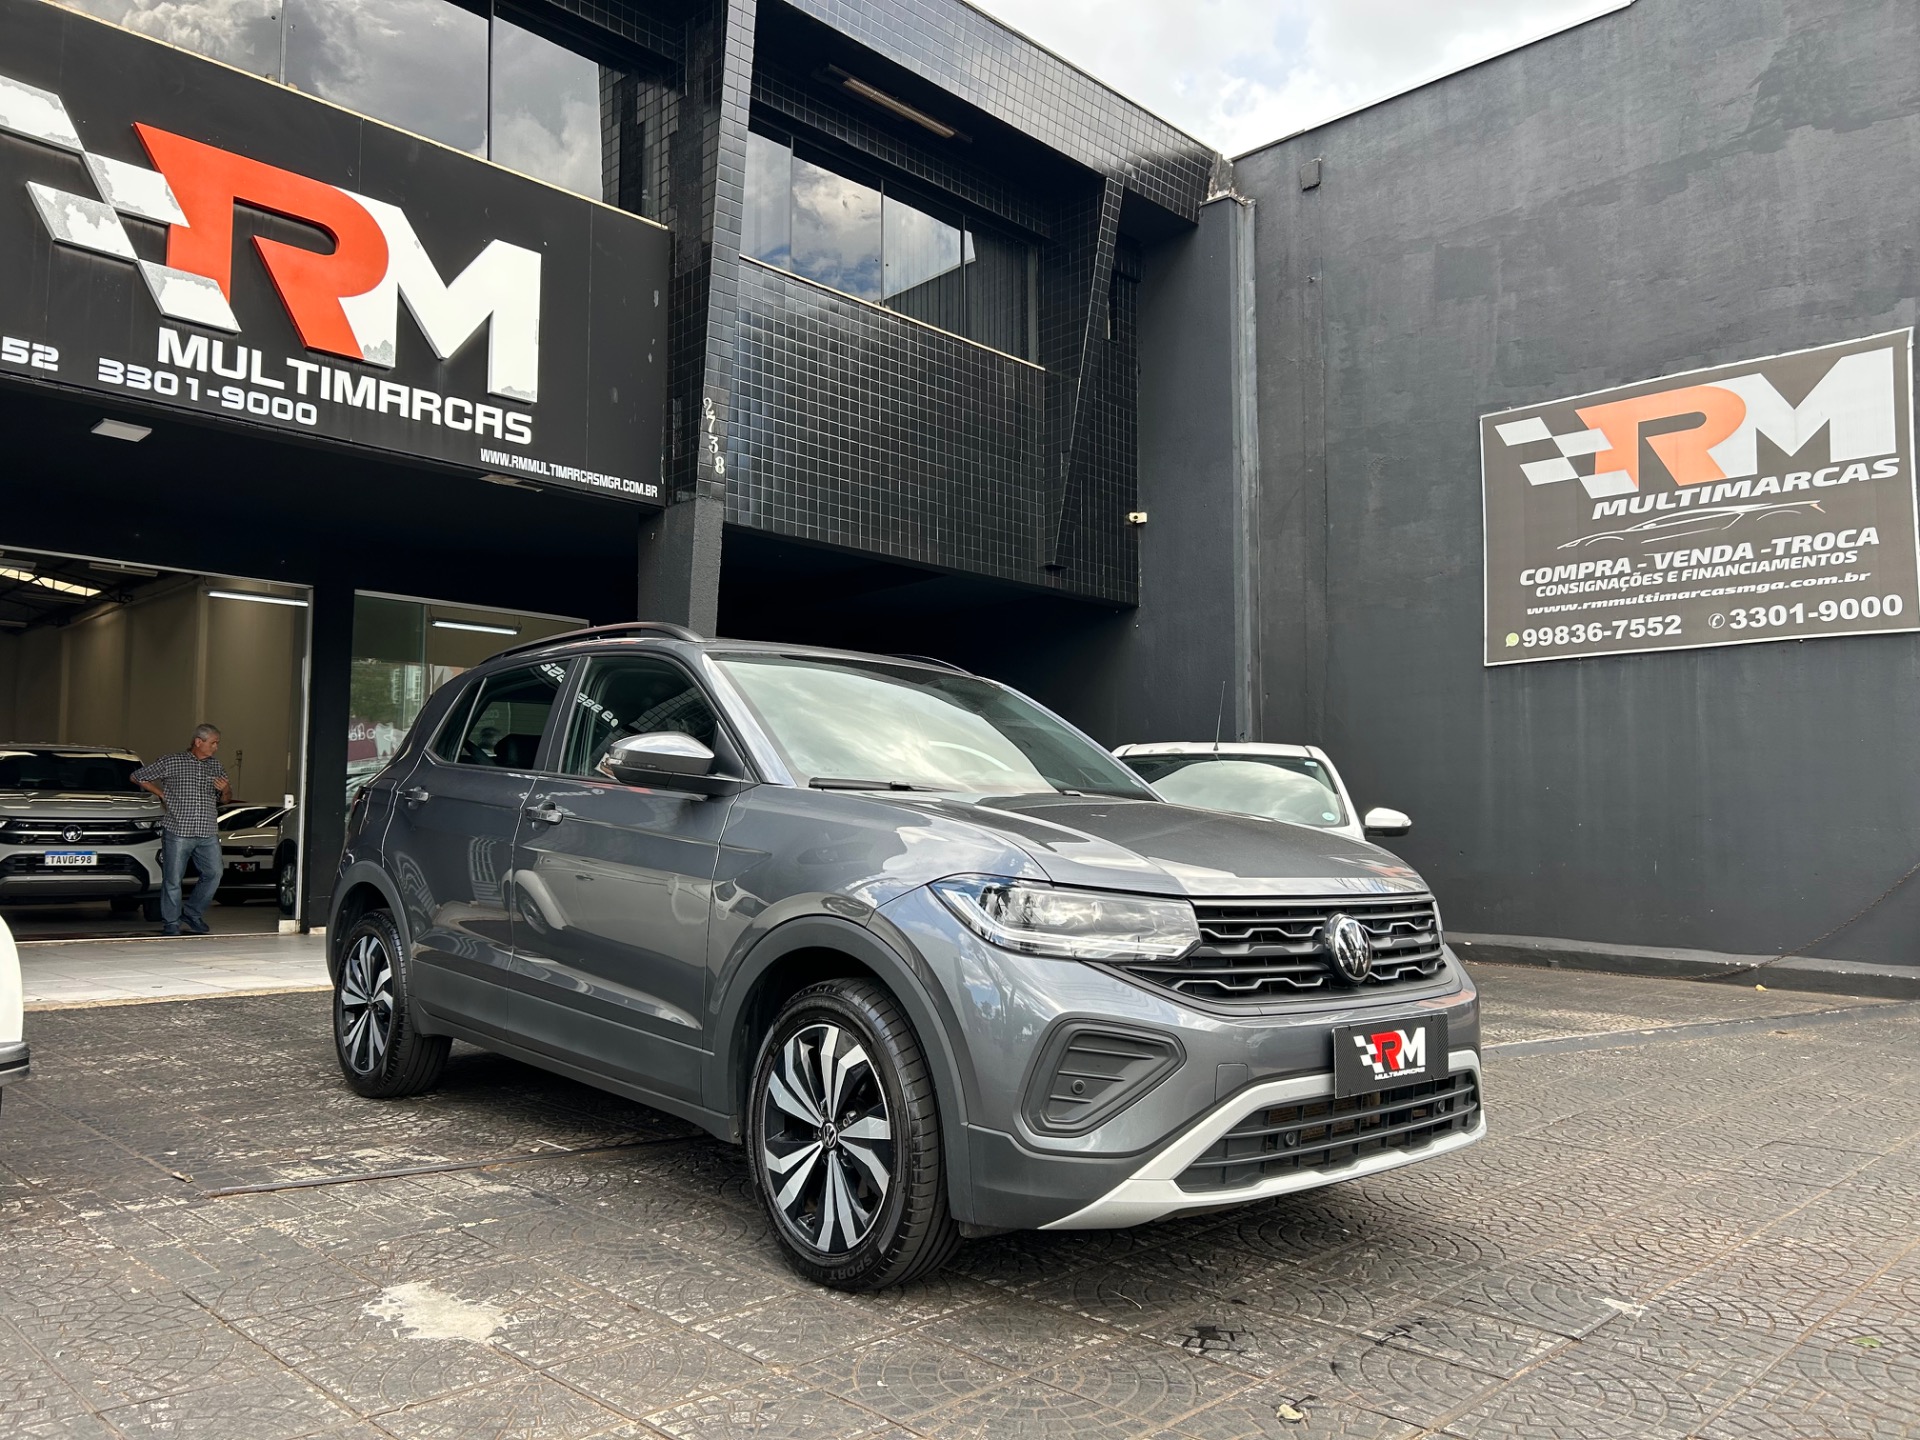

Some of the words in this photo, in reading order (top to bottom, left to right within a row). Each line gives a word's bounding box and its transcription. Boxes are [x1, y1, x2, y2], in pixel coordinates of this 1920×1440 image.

[134, 122, 541, 403] RM
[1, 336, 59, 372] 52
[98, 357, 318, 427] 3301-9000
[157, 326, 533, 445] MULTIMARCAS
[702, 396, 726, 475] 2738
[1574, 346, 1897, 490] RM
[480, 447, 658, 499] WWW.RMMULTIMARCASMGA.COM.BR
[1592, 457, 1900, 520] MULTIMARCAS
[1519, 557, 1632, 587] COMPRA
[1652, 542, 1754, 571] VENDA
[1535, 572, 1664, 598] CONSIGNAÇÕES
[1667, 570, 1679, 583] E
[1681, 549, 1858, 582] FINANCIAMENTOS
[1522, 614, 1682, 648] 99836-7552
[1729, 593, 1904, 630] 3301-9000
[1526, 572, 1872, 615] www.rmmultimarcasmga.com.br
[1370, 1026, 1426, 1071] RM
[829, 1253, 873, 1281] SPORT
